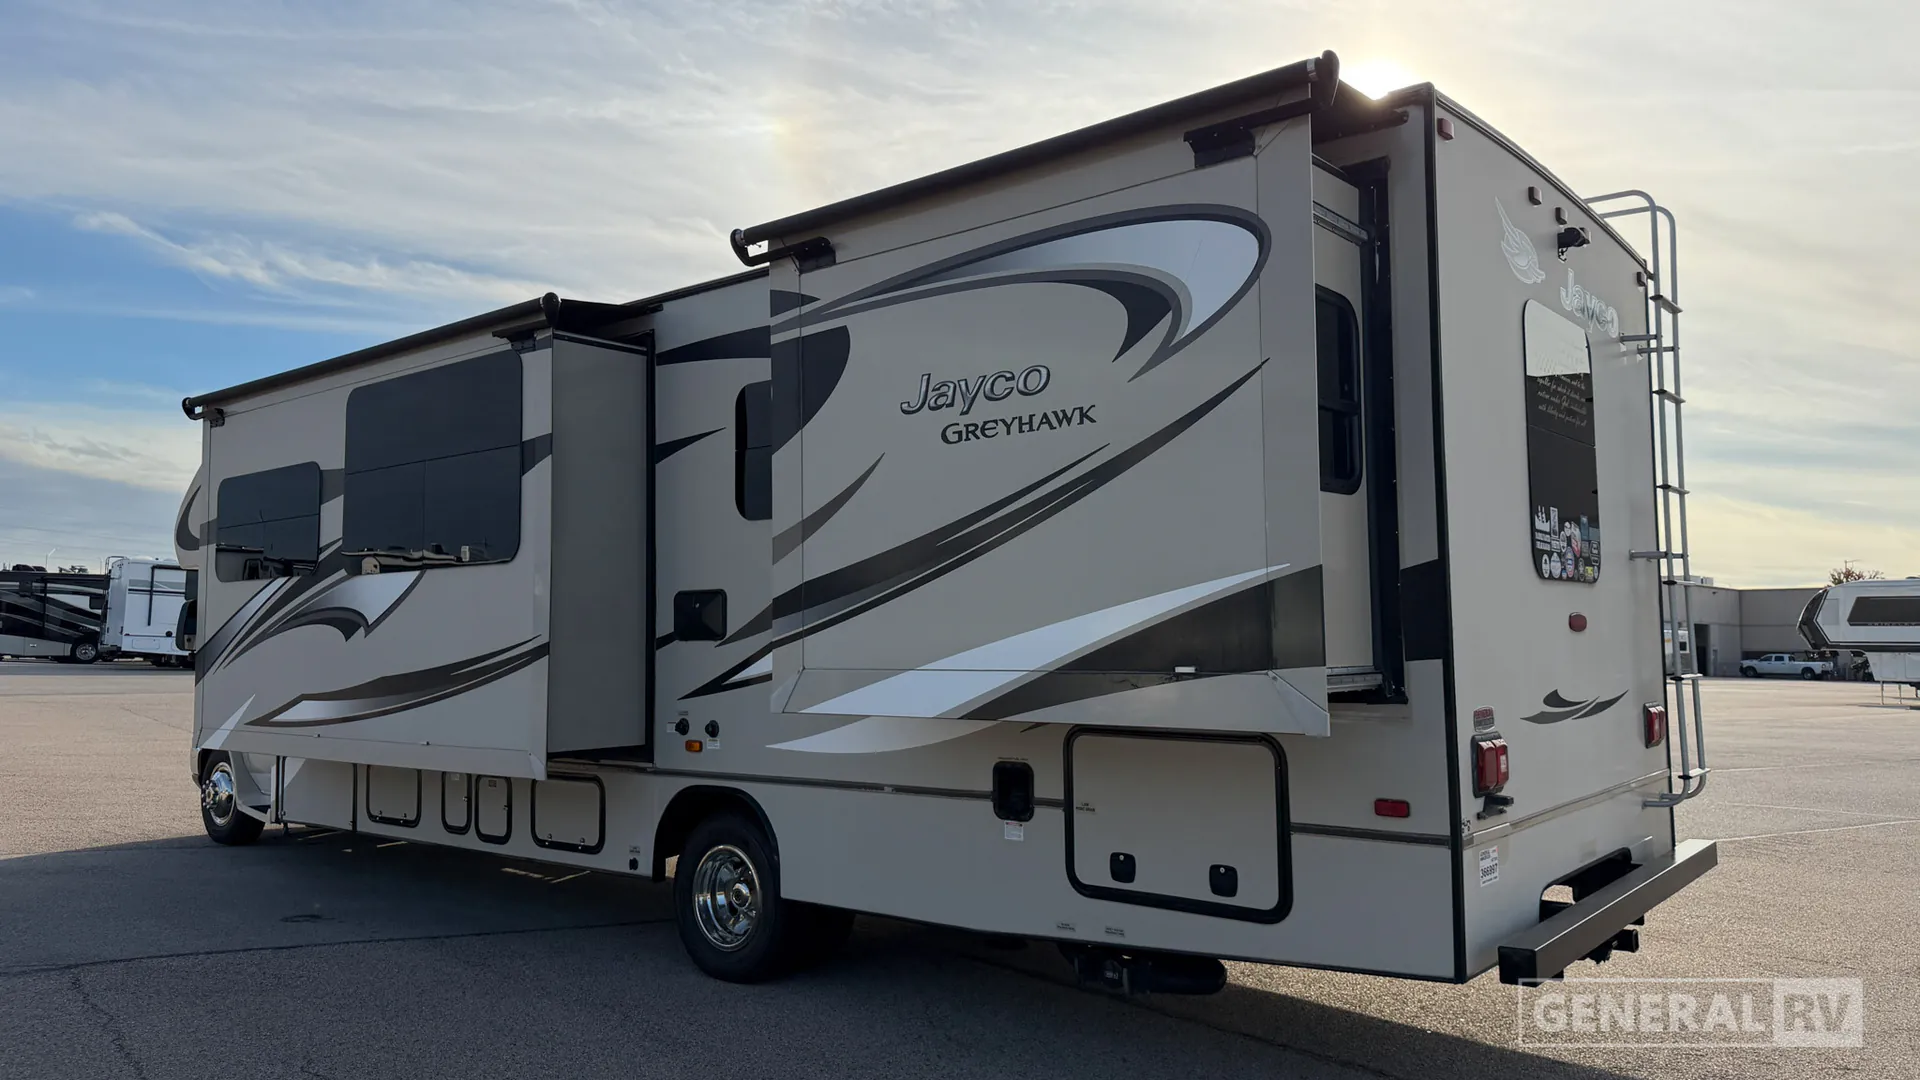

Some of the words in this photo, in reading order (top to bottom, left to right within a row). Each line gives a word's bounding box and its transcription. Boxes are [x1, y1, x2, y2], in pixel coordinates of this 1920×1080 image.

[1560, 267, 1619, 338] Jayco
[900, 365, 1051, 415] Jayco
[941, 404, 1097, 445] GREYHAWK
